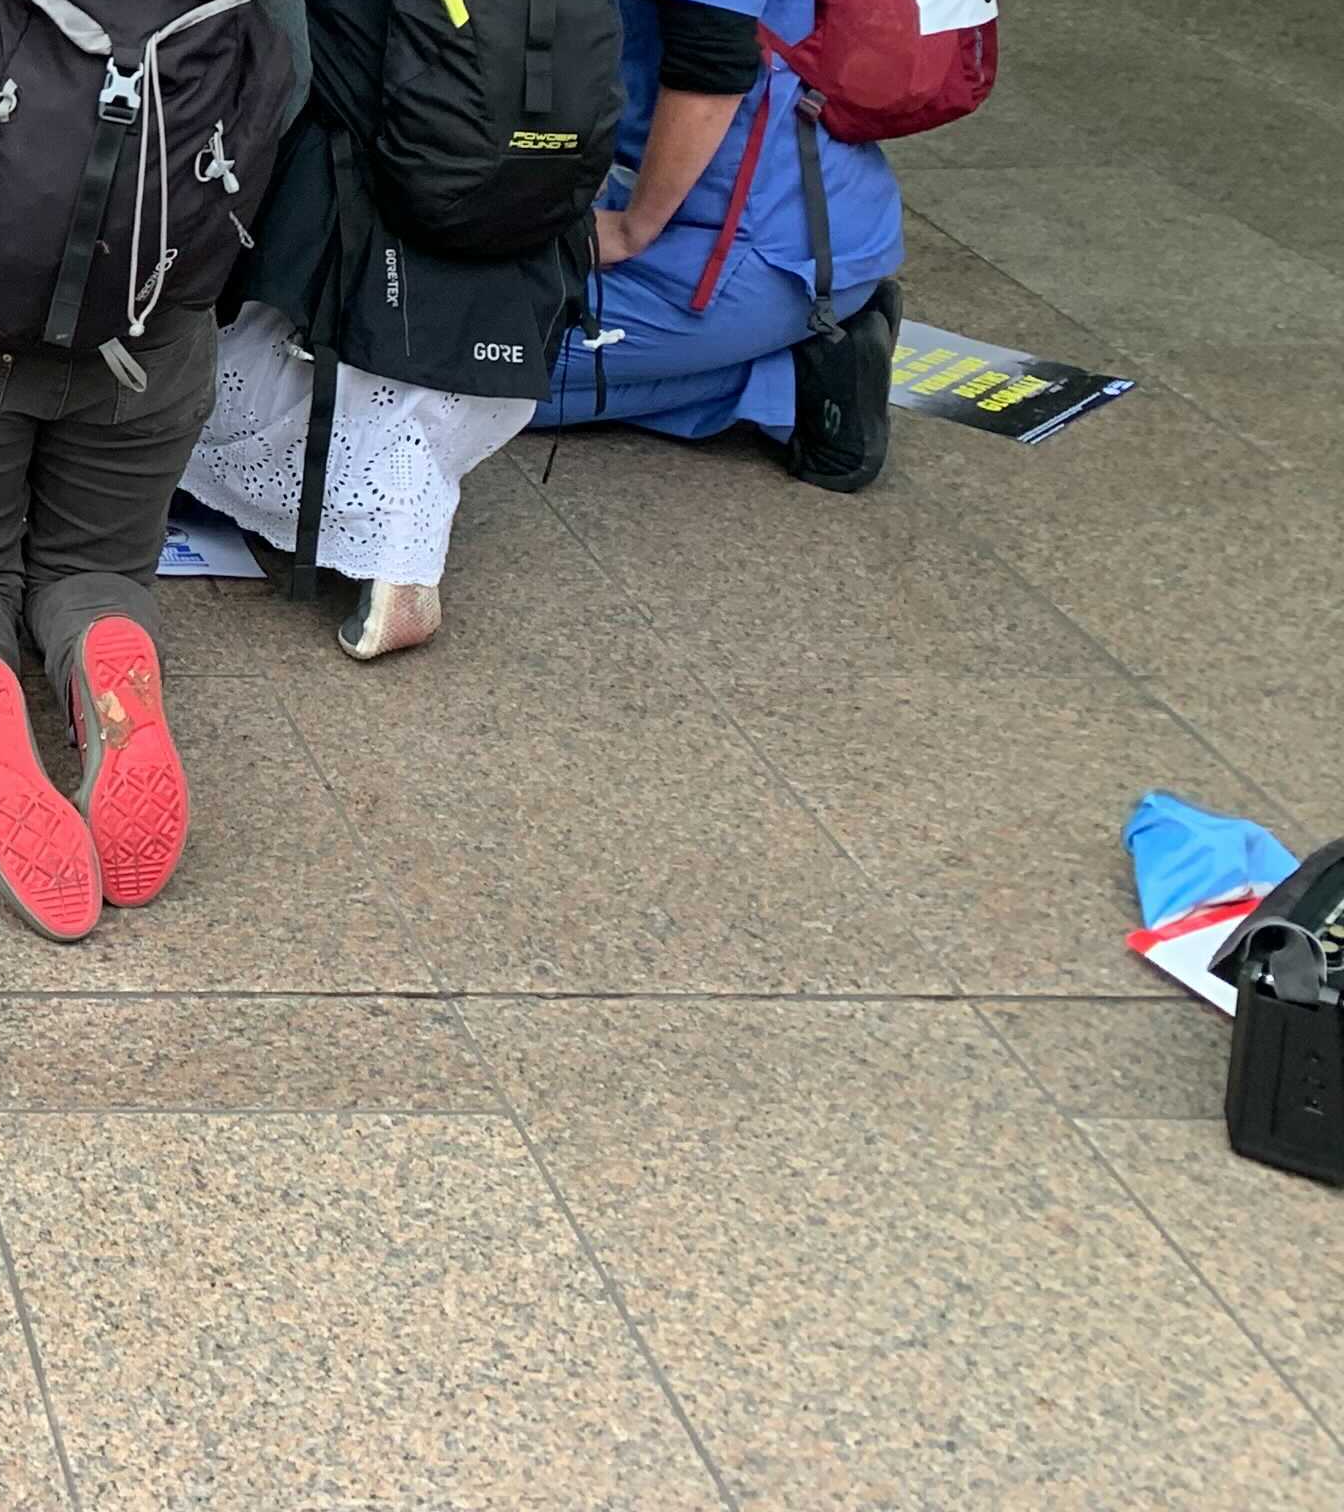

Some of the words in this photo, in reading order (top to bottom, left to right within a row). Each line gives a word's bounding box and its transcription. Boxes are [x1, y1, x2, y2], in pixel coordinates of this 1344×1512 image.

[513, 131, 579, 140] POWDER
[509, 140, 561, 149] HOUND
[474, 343, 524, 363] GORE
